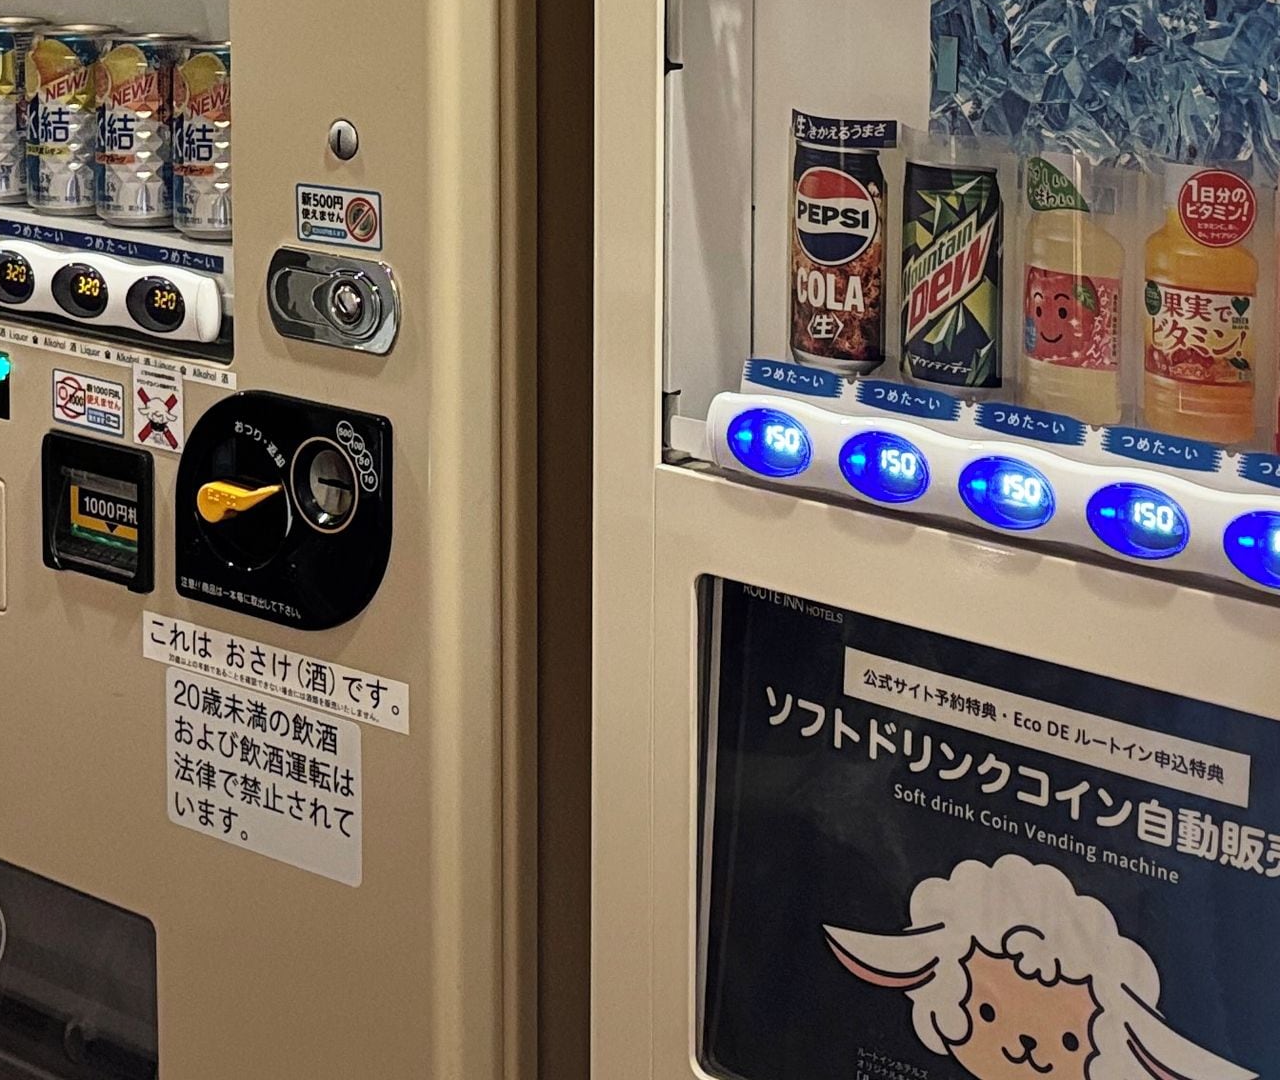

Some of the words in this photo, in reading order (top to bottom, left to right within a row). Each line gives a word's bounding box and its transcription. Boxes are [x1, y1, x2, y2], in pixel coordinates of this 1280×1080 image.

[797, 200, 870, 229] PEPSI
[1186, 199, 1249, 222] ビタミン!
[78, 277, 100, 297] 320
[796, 267, 866, 313] COLA
[1161, 292, 1234, 319] 果実で
[193, 368, 218, 383] Alkohol
[234, 420, 286, 469] おつり・返却
[338, 426, 353, 438] 500
[350, 439, 364, 451] 100
[766, 426, 800, 449] 150
[358, 456, 370, 467] 50
[363, 474, 375, 485] 10
[806, 605, 844, 624] HOTELS
[150, 620, 212, 659] これは
[173, 680, 339, 756] 20歳未満の飲酒
[173, 716, 355, 797] および飲酒運転は
[173, 752, 354, 839] 法律で禁止されて
[174, 791, 249, 842] います。
[893, 782, 927, 804] Soft
[930, 792, 976, 824] drink
[979, 808, 1020, 836] Coin
[1026, 821, 1099, 863] Vending
[1103, 842, 1180, 886] machine
